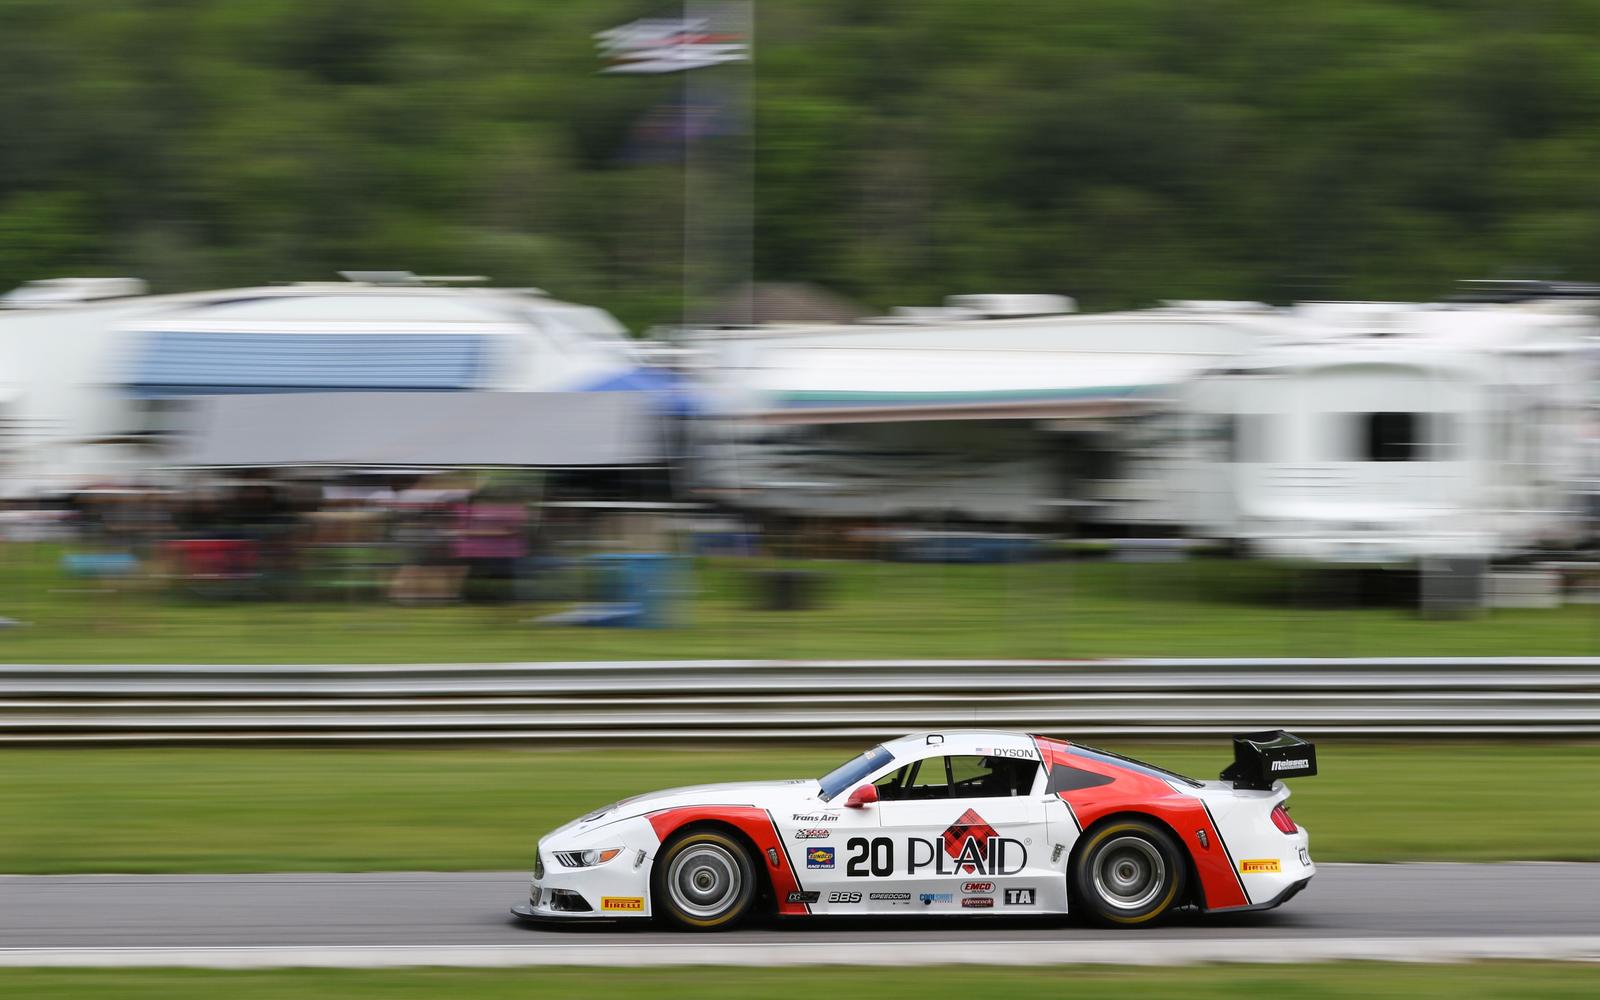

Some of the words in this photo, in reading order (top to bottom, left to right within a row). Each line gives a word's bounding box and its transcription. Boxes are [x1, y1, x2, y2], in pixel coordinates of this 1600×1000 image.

[993, 748, 1034, 757] DYSON
[792, 813, 819, 821] Trans
[846, 837, 894, 877] 20
[907, 837, 1028, 875] PLAID
[1243, 862, 1277, 870] PIRELLI
[965, 883, 992, 891] EMCO
[829, 892, 861, 902] BBS
[1008, 890, 1031, 904] TA
[604, 899, 641, 909] PIRELLI
